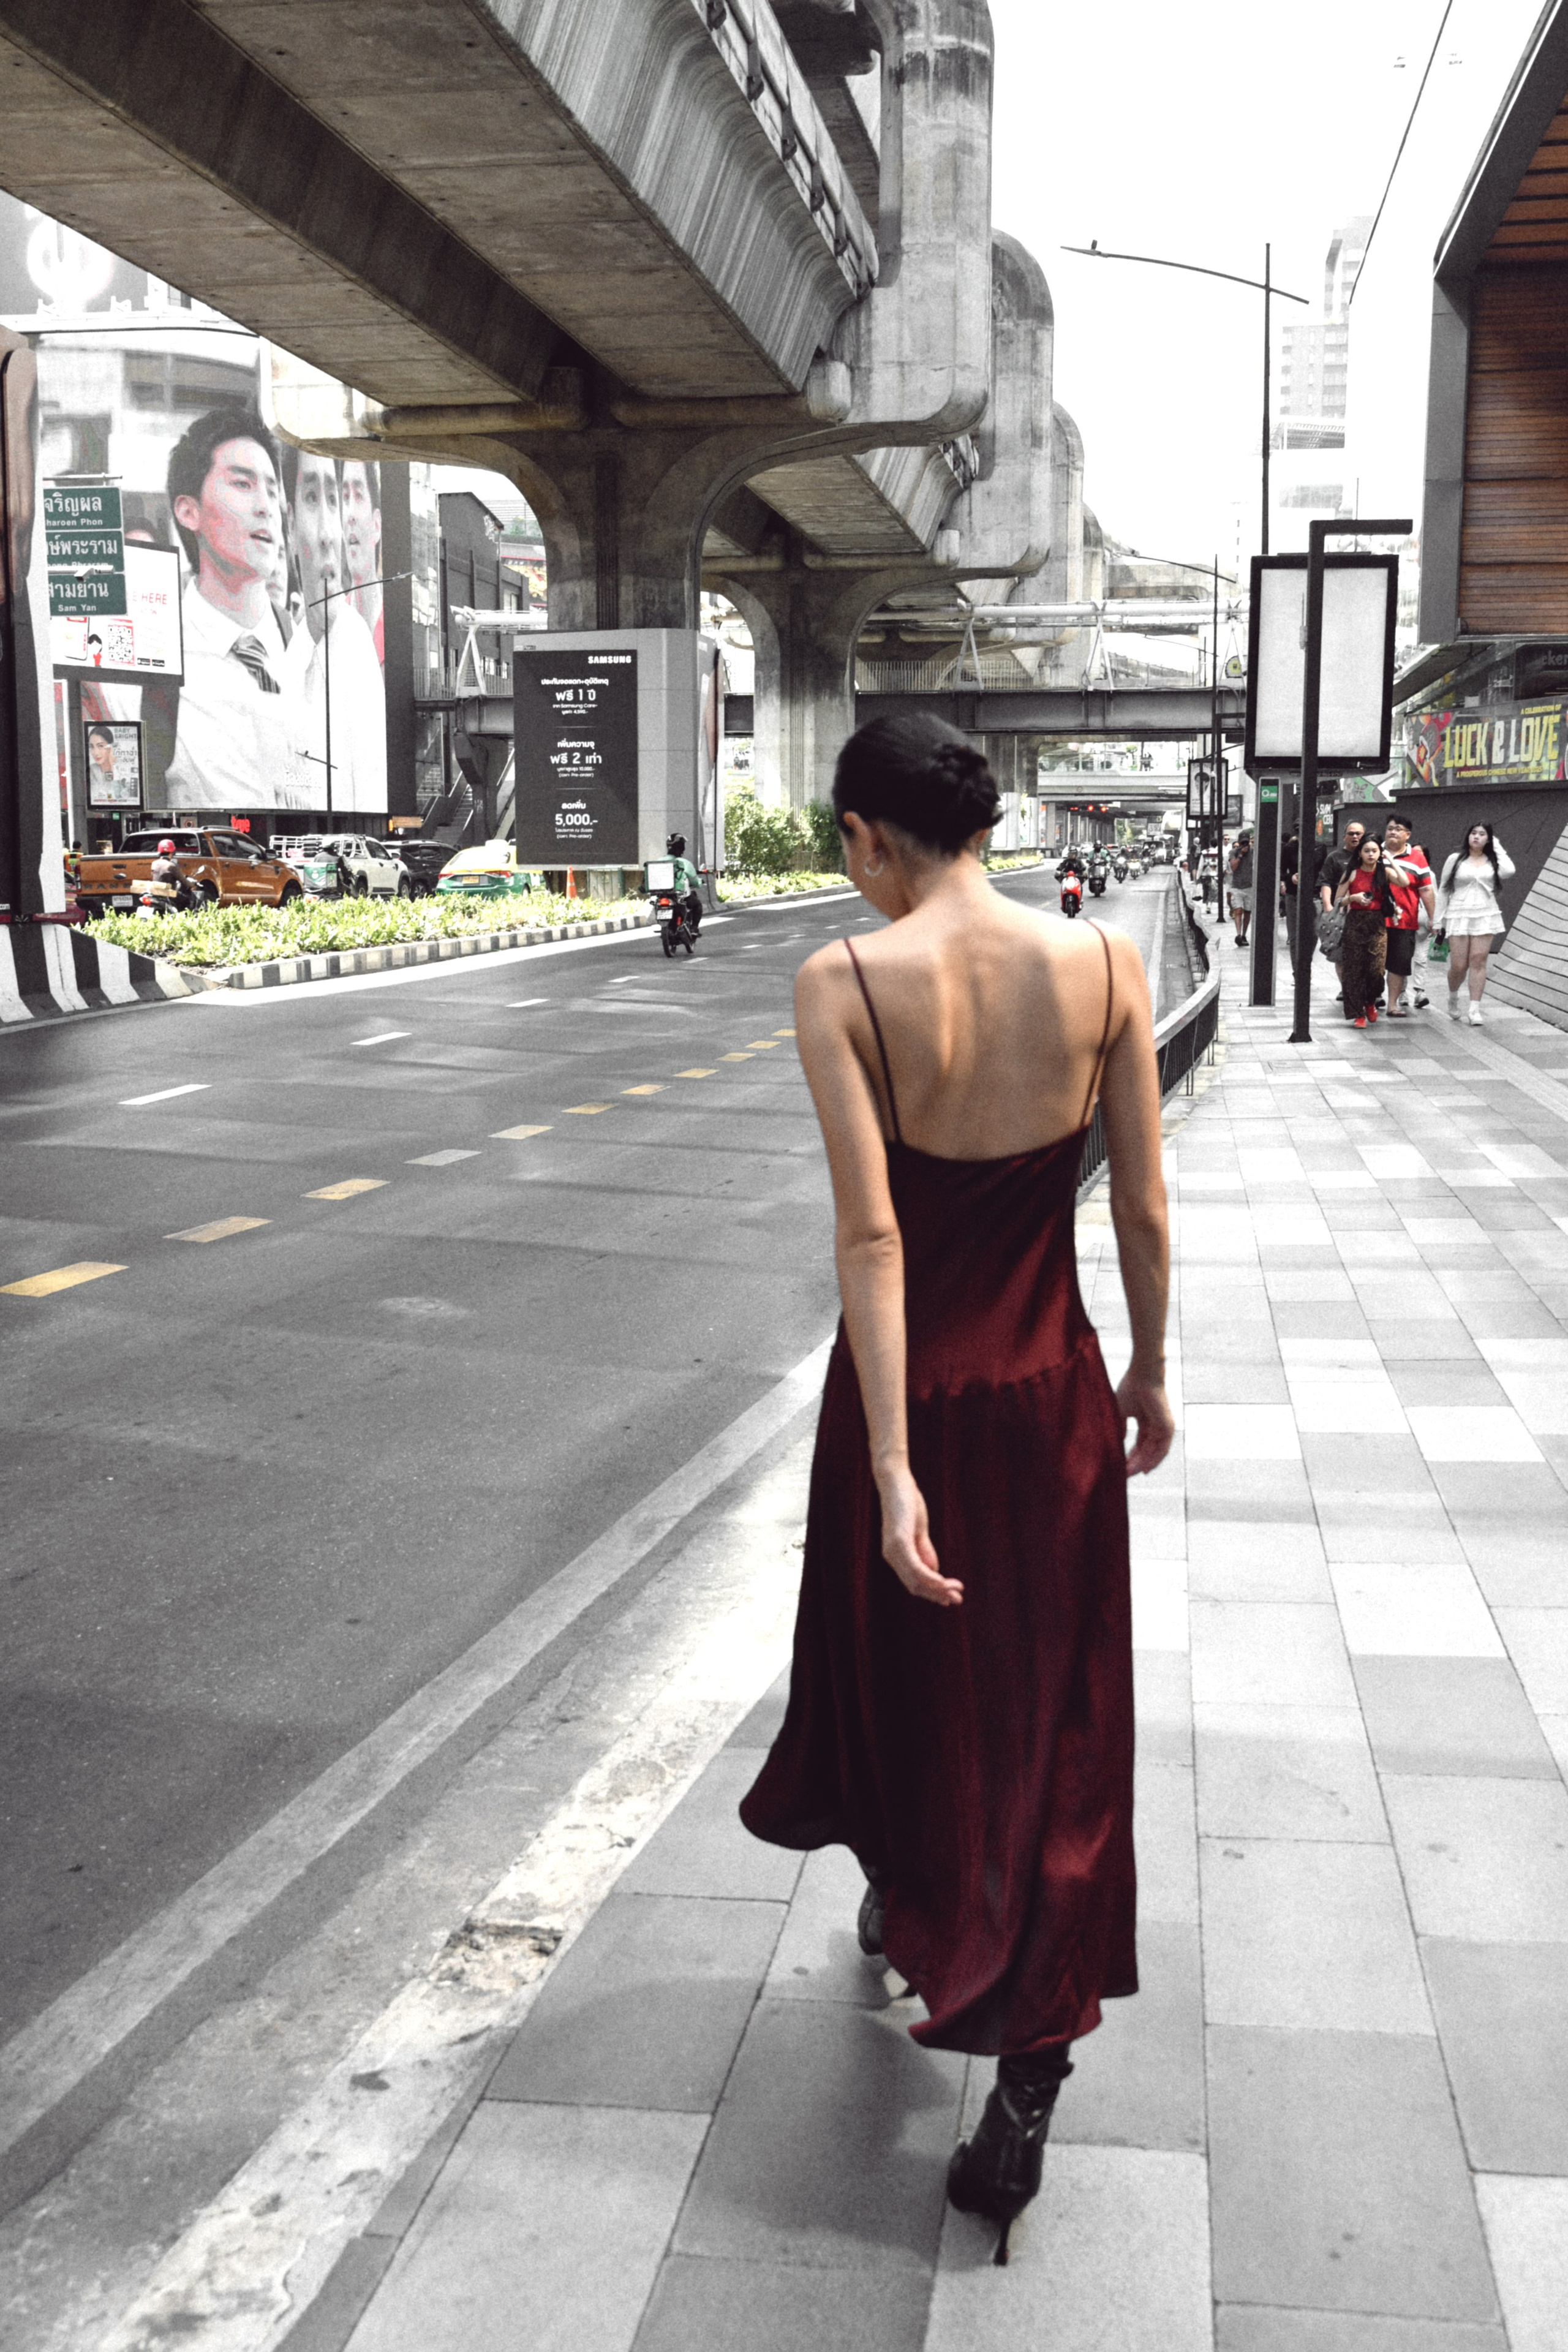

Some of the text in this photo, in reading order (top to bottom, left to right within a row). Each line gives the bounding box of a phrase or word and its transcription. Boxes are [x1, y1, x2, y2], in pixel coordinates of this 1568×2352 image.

[44, 492, 102, 516] จริญผล
[47, 535, 118, 555] ษ์พระราม
[141, 592, 167, 605] HERE
[587, 655, 632, 664] SAMSUNG
[555, 688, 597, 701] ฟรี 1 ปี
[1443, 722, 1489, 768] LUCK
[1509, 714, 1561, 763] LOVE
[550, 752, 602, 764] ฟรี 2 เท่า
[555, 813, 598, 827] 5,000.-
